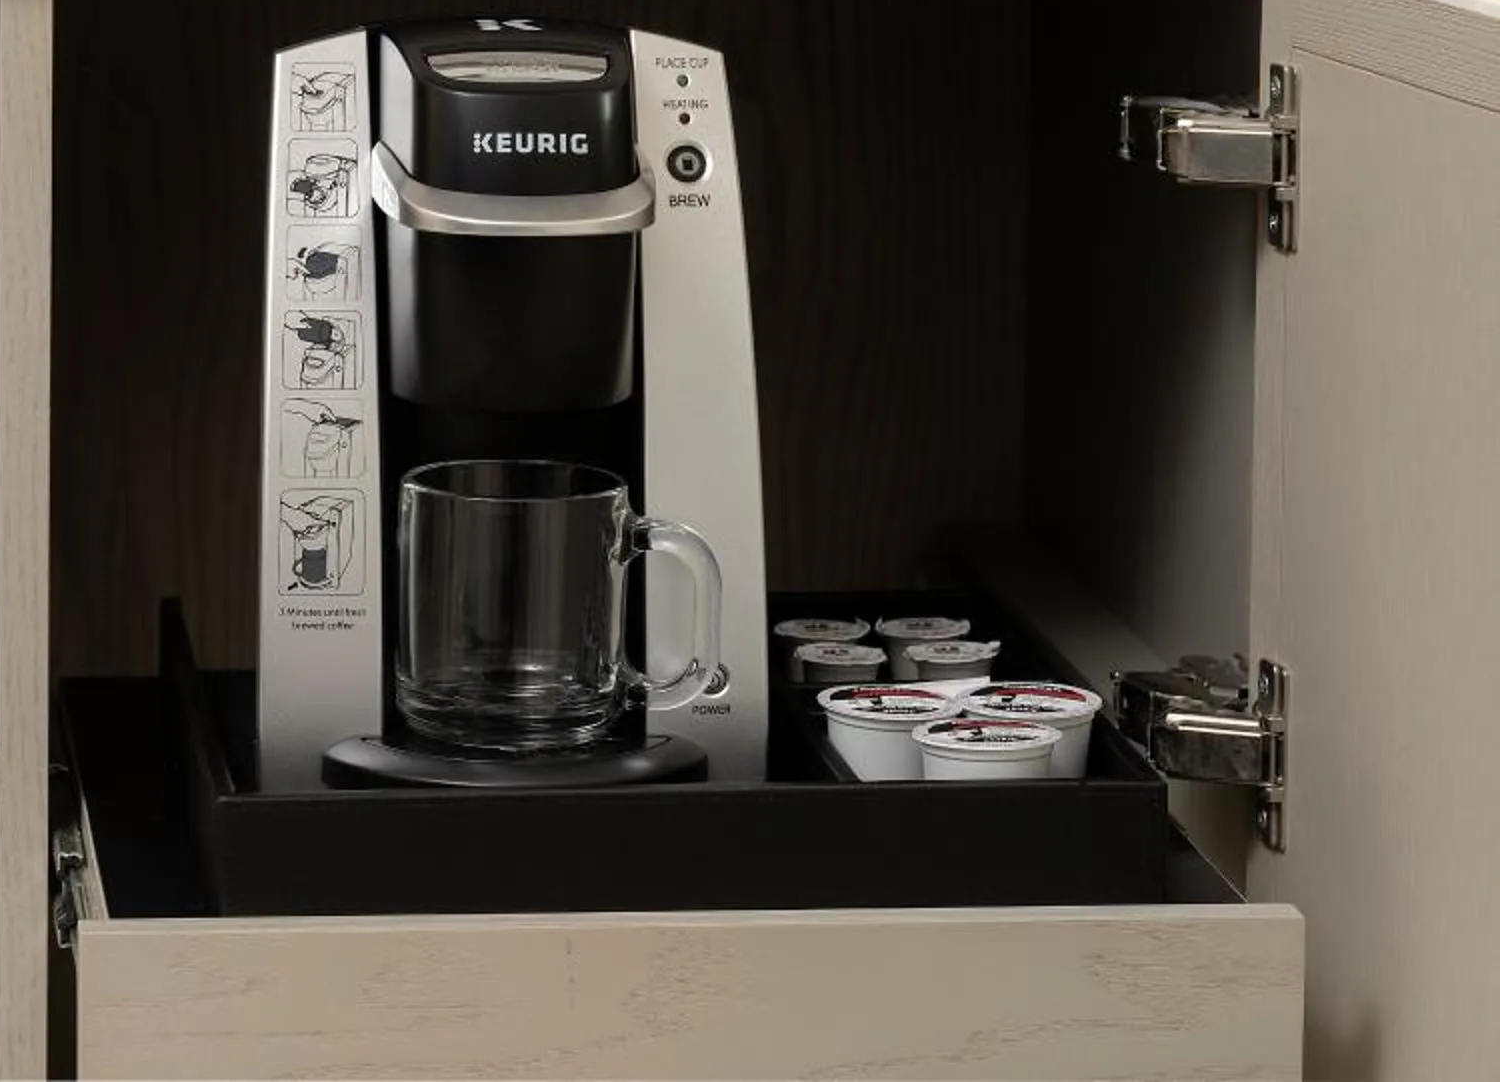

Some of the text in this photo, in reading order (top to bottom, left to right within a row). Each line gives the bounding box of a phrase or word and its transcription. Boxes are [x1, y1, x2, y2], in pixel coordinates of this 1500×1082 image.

[655, 57, 710, 69] PLACE CUP
[662, 98, 709, 110] HEATING
[472, 131, 590, 155] KEURIG
[668, 194, 712, 208] BREW
[692, 704, 732, 716] POWER
